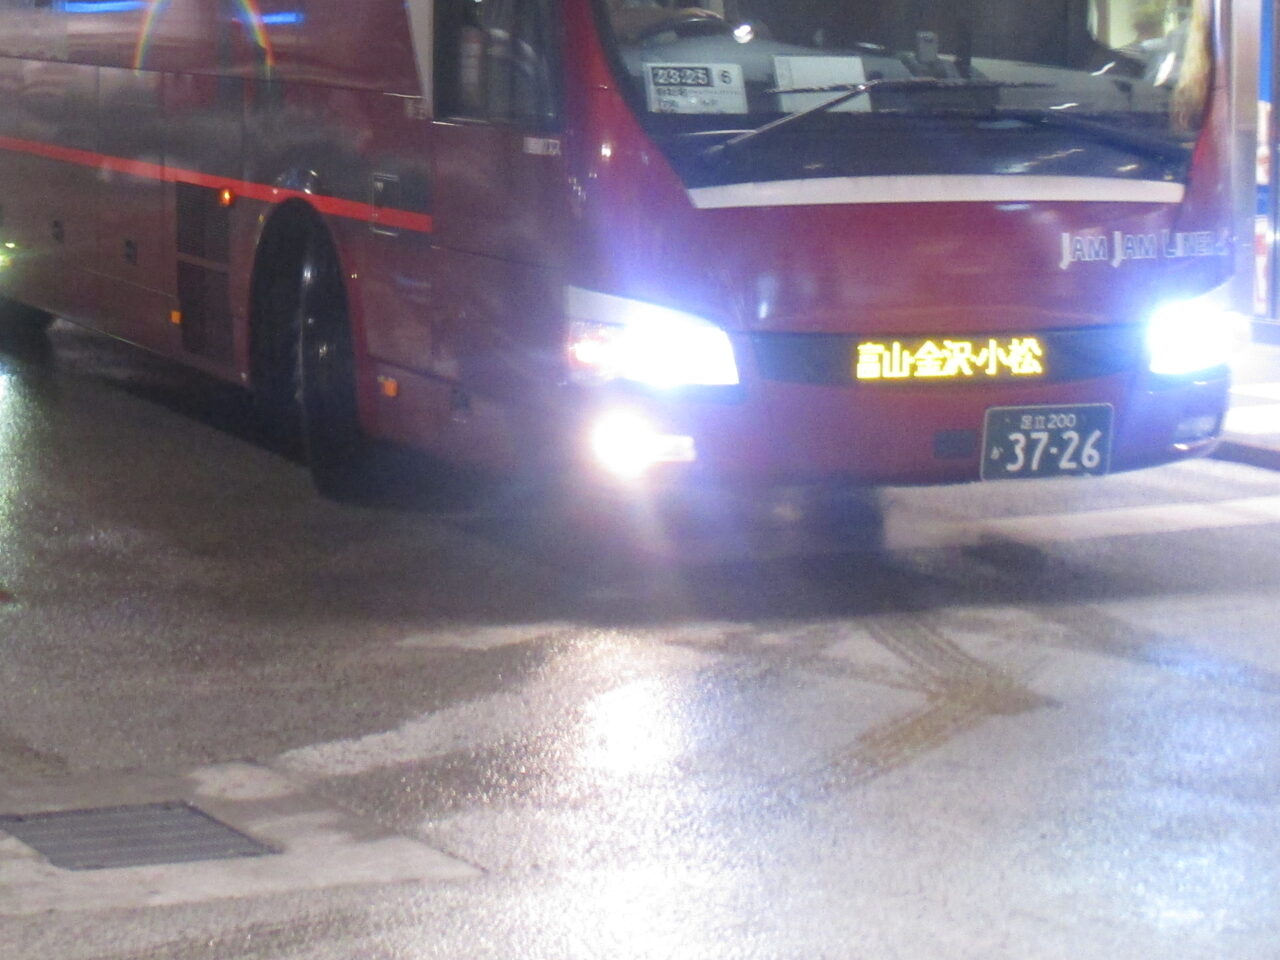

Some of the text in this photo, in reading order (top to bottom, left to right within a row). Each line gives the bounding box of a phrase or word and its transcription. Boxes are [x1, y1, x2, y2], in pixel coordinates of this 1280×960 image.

[1059, 231, 1107, 271] JAM
[1111, 230, 1157, 268] JAM
[1047, 413, 1077, 429] 200
